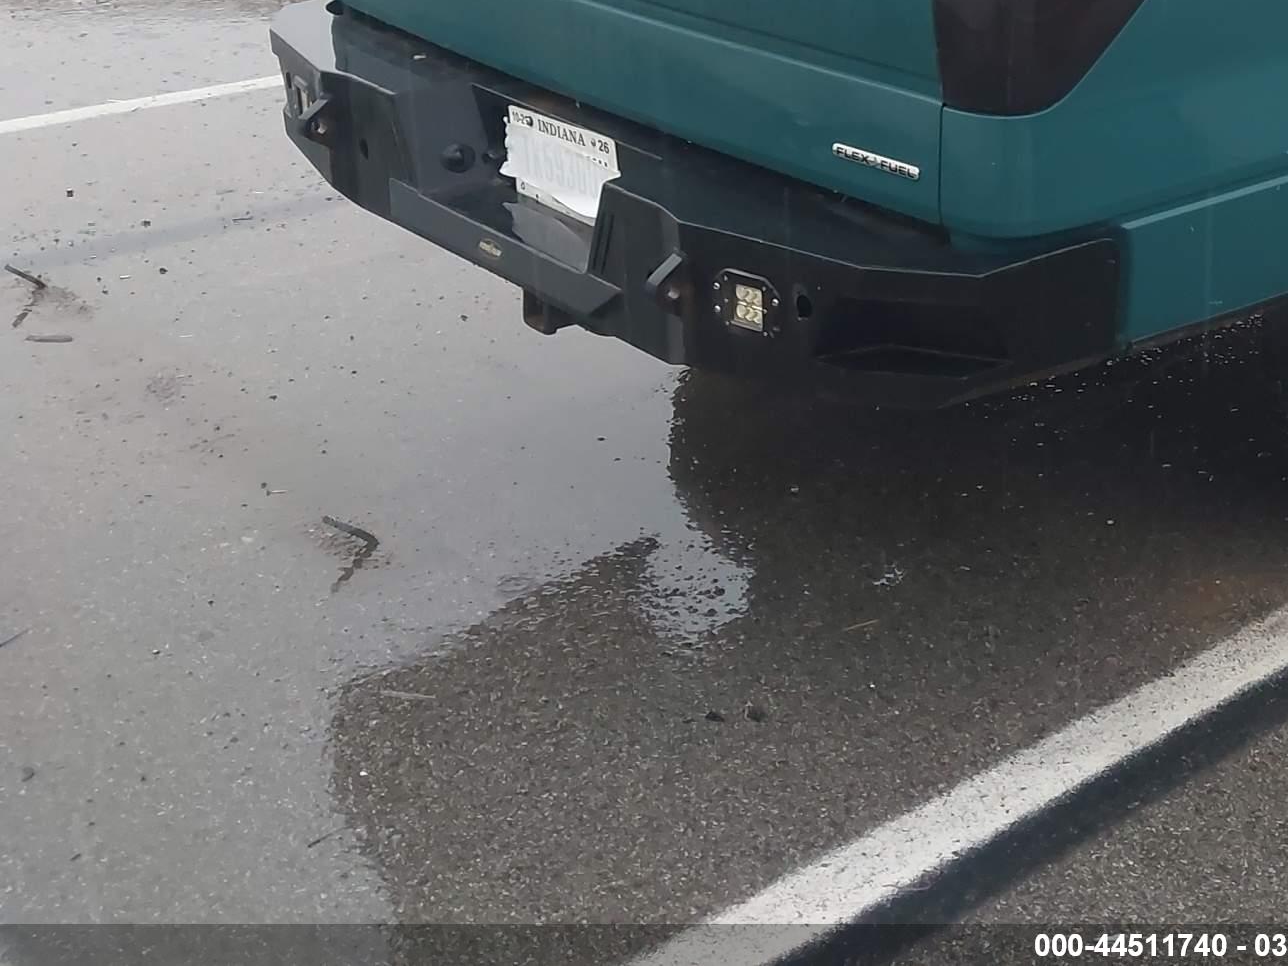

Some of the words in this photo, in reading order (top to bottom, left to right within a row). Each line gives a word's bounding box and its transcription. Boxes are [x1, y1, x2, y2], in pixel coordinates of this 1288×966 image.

[537, 118, 586, 147] INDIANA
[597, 139, 610, 154] 26
[836, 145, 870, 165] FLEX
[880, 160, 918, 179] FUEL
